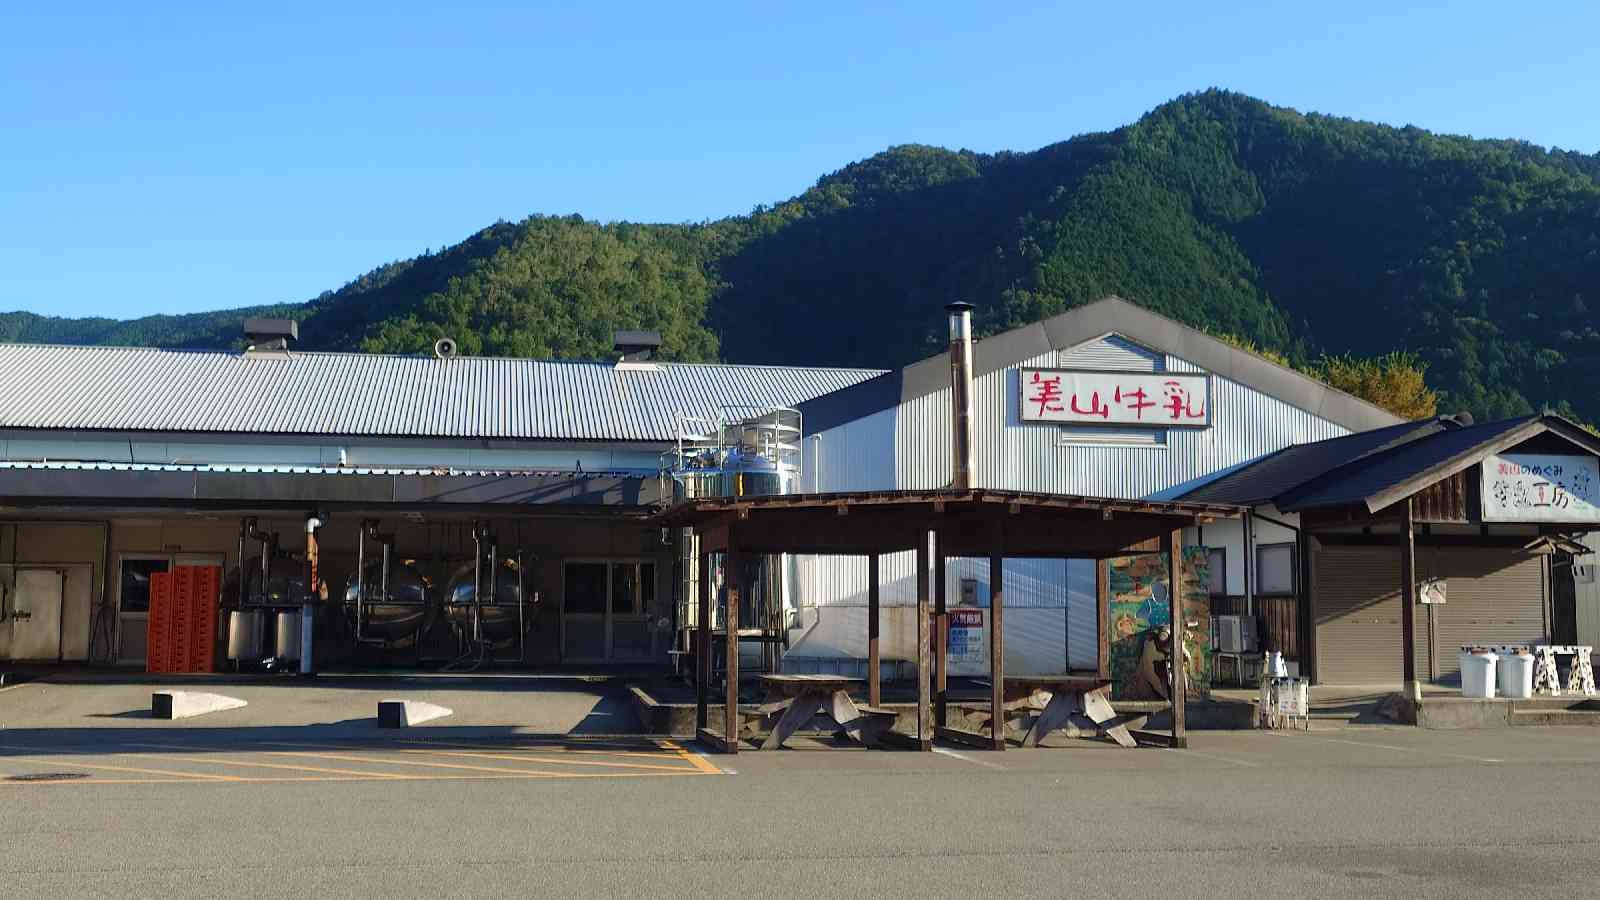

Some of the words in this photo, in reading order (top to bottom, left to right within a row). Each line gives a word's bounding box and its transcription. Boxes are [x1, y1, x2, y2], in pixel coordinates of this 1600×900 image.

[1029, 371, 1205, 420] 美山牛乳
[1497, 463, 1563, 476] 美山のめぐみ
